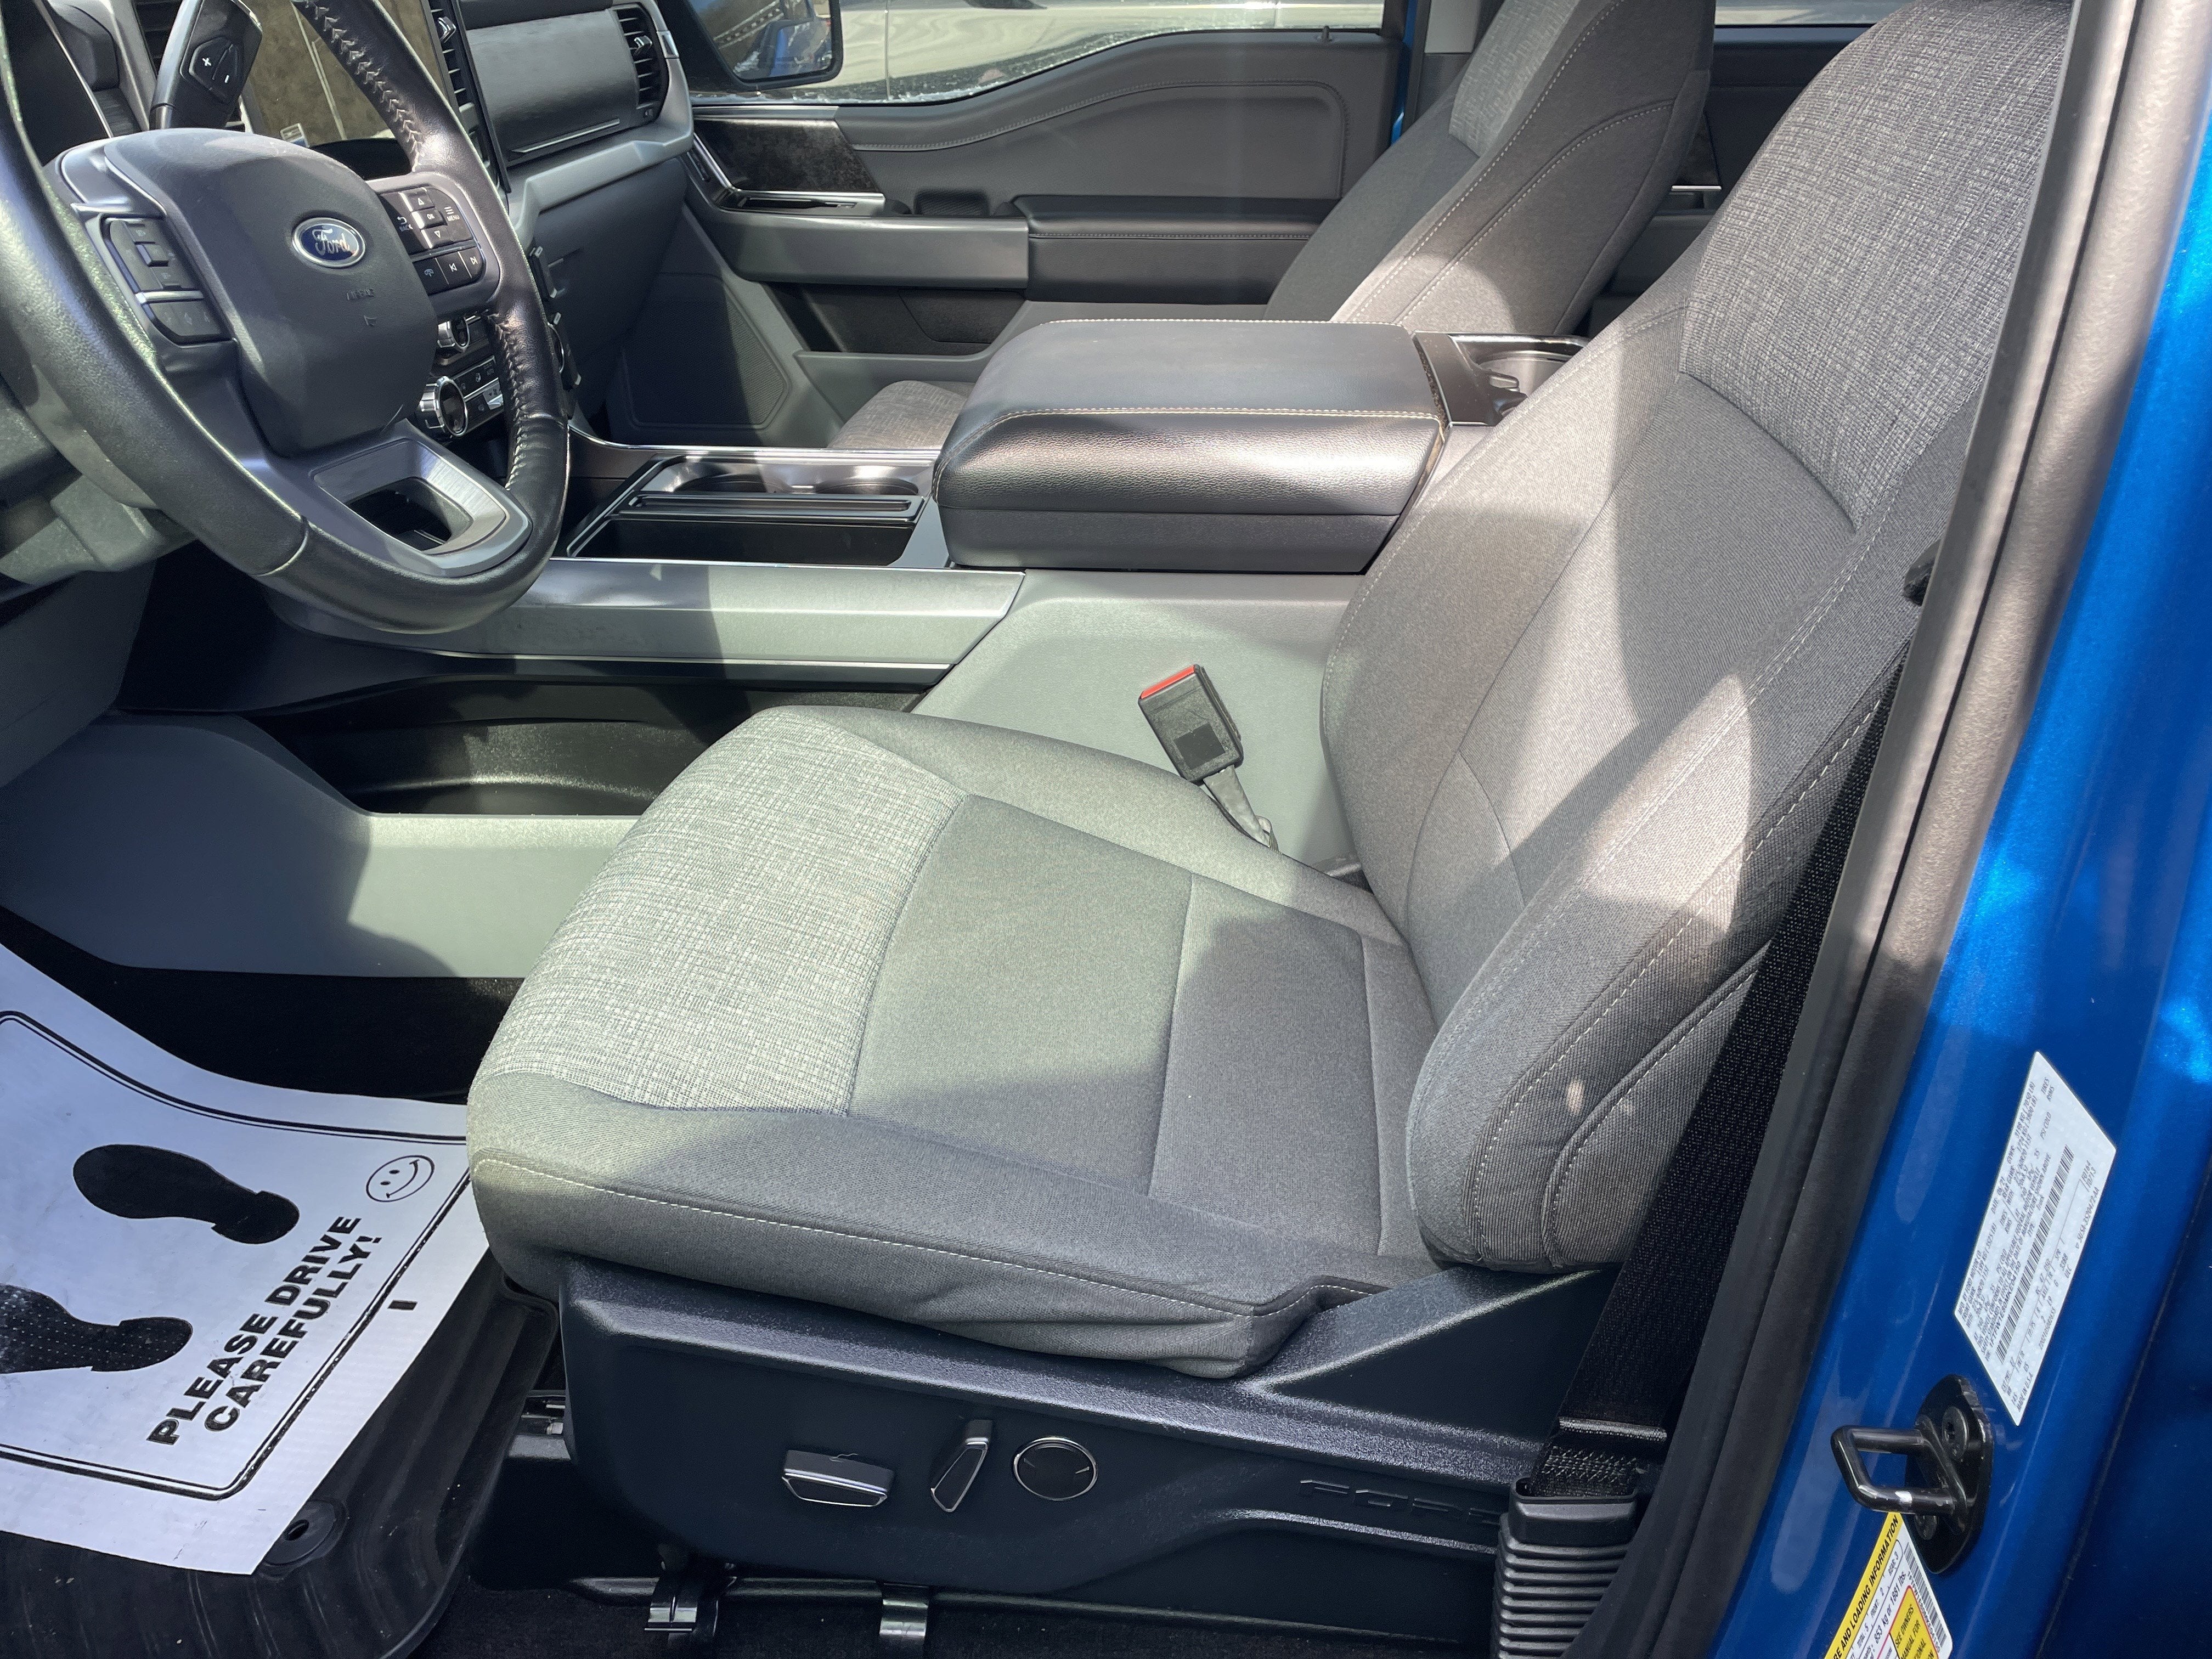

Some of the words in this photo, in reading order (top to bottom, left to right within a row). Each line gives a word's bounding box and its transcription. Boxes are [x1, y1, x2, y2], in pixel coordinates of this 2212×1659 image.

[312, 228, 349, 255] Ford
[2019, 1113, 2025, 1122] KG
[2022, 1127, 2027, 1136] KG
[2015, 1209, 2019, 1218] AT
[2034, 1149, 2039, 1159] 35
[1982, 1314, 1990, 1336] VEHICLE
[1989, 1284, 2000, 1315] CONFORMS
[1999, 1277, 2003, 1285] TO
[2005, 1235, 2017, 1267] APPLICABLE
[2015, 1211, 2025, 1235] FEDERAL
[2023, 1190, 2032, 1212] MOTOR
[2030, 1167, 2039, 1190] VEHICLE
[1982, 1252, 1987, 1261] KG
[1981, 1335, 1989, 1355] SAFETY
[1988, 1305, 2000, 1336] STANDARDS
[1998, 1297, 2002, 1306] IN
[2000, 1280, 2008, 1299] EFFECT
[2006, 1270, 2011, 1280] ON
[2018, 1237, 2023, 1245] OF
[2021, 1195, 2036, 1237] MANUFACTURE
[2034, 1173, 2044, 1196] SHOWN
[2039, 1274, 2045, 1284] 47
[1963, 1293, 1967, 1301] BY
[1974, 1333, 1978, 1341] AT
[1990, 1284, 1995, 1293] 35
[146, 1313, 278, 1446] PLEASE
[264, 1216, 362, 1305] DRIVE
[205, 1235, 382, 1431] CAREFULLY!
[2023, 1362, 2029, 1372] US
[2022, 1387, 2027, 1396] IN
[1841, 1628, 1851, 1651] AND
[1852, 1584, 1871, 1630] LOADING
[1871, 1515, 1898, 1587] INFORMATION
[1881, 1613, 1888, 1628] kg
[1887, 1605, 1892, 1616] or
[1912, 1620, 1921, 1638] FOR
